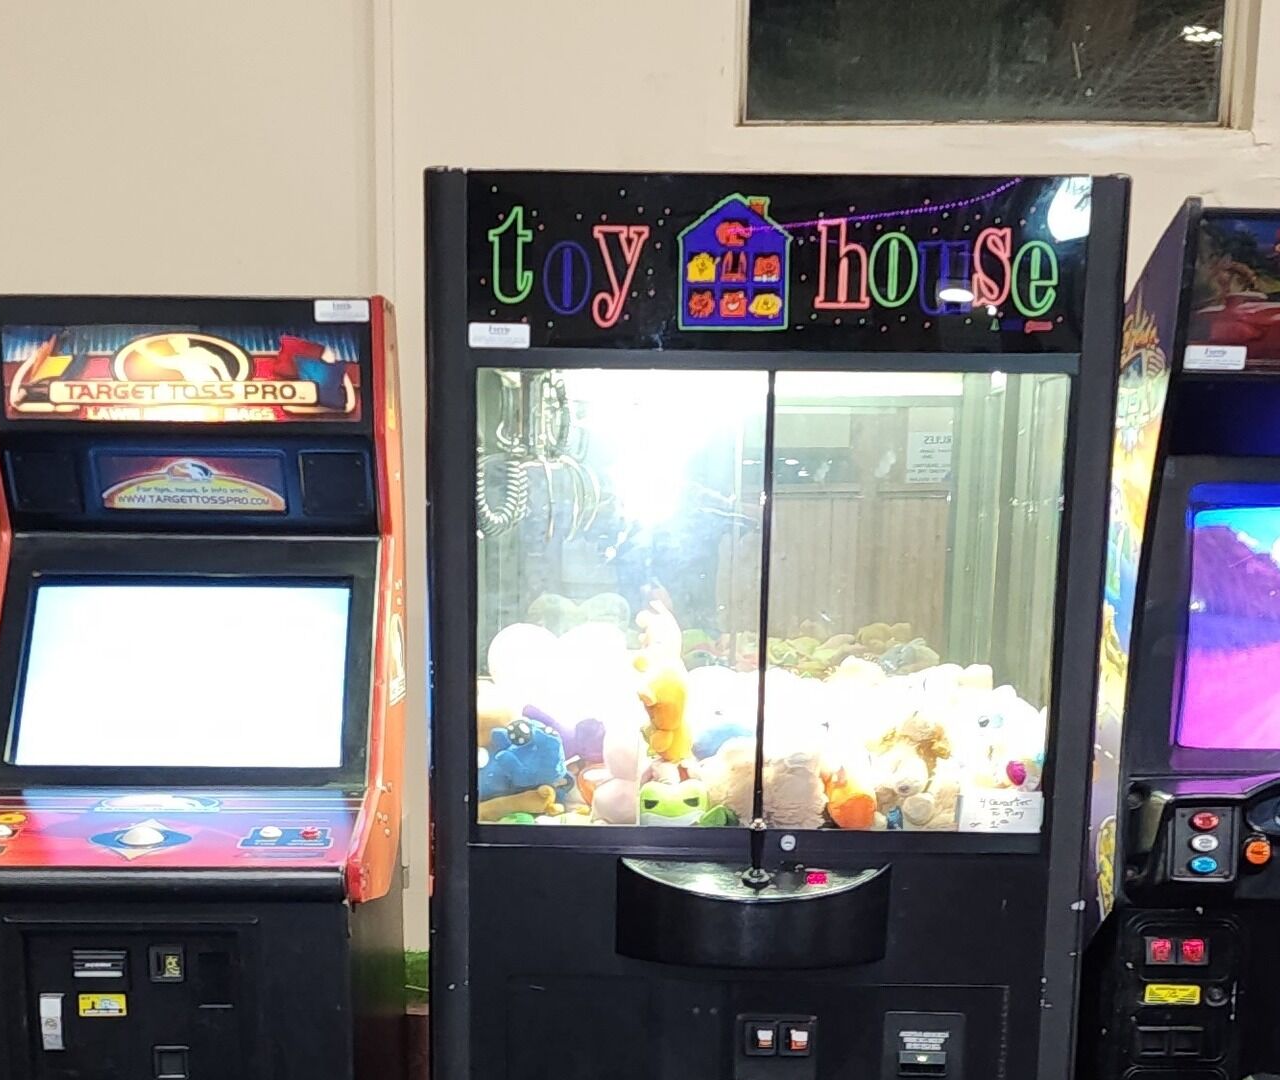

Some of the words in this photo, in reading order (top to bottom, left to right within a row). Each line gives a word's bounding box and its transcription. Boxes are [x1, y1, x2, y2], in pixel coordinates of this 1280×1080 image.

[488, 206, 649, 328] toy
[815, 217, 1059, 317] house
[64, 384, 157, 401] TARGET
[169, 384, 236, 401] TOSS
[244, 383, 298, 401] PRO
